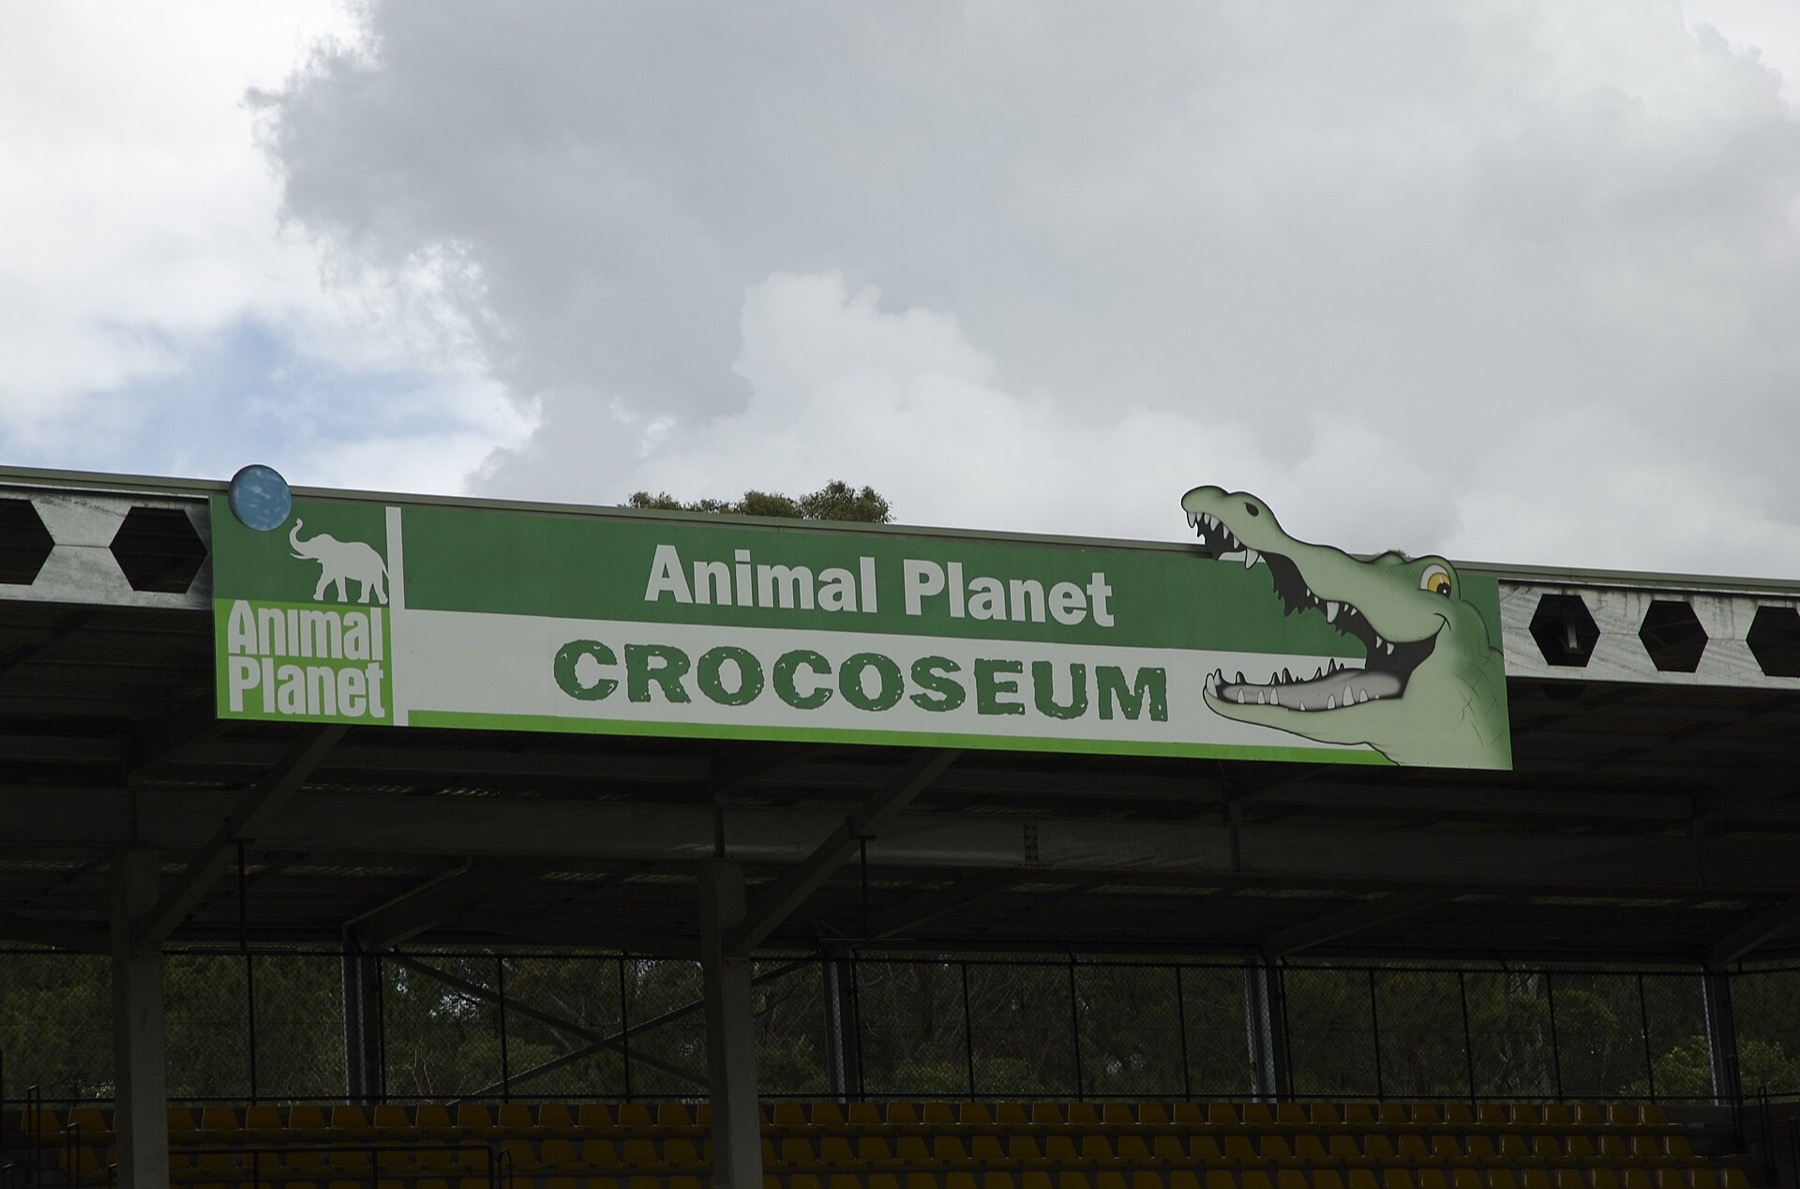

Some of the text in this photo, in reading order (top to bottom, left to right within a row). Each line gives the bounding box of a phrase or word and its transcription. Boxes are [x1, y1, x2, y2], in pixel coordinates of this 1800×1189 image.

[644, 544, 1115, 627] Animal Planet
[227, 600, 384, 661] Animal
[228, 655, 386, 719] Planet
[553, 639, 1168, 722] CROCOSEUM
